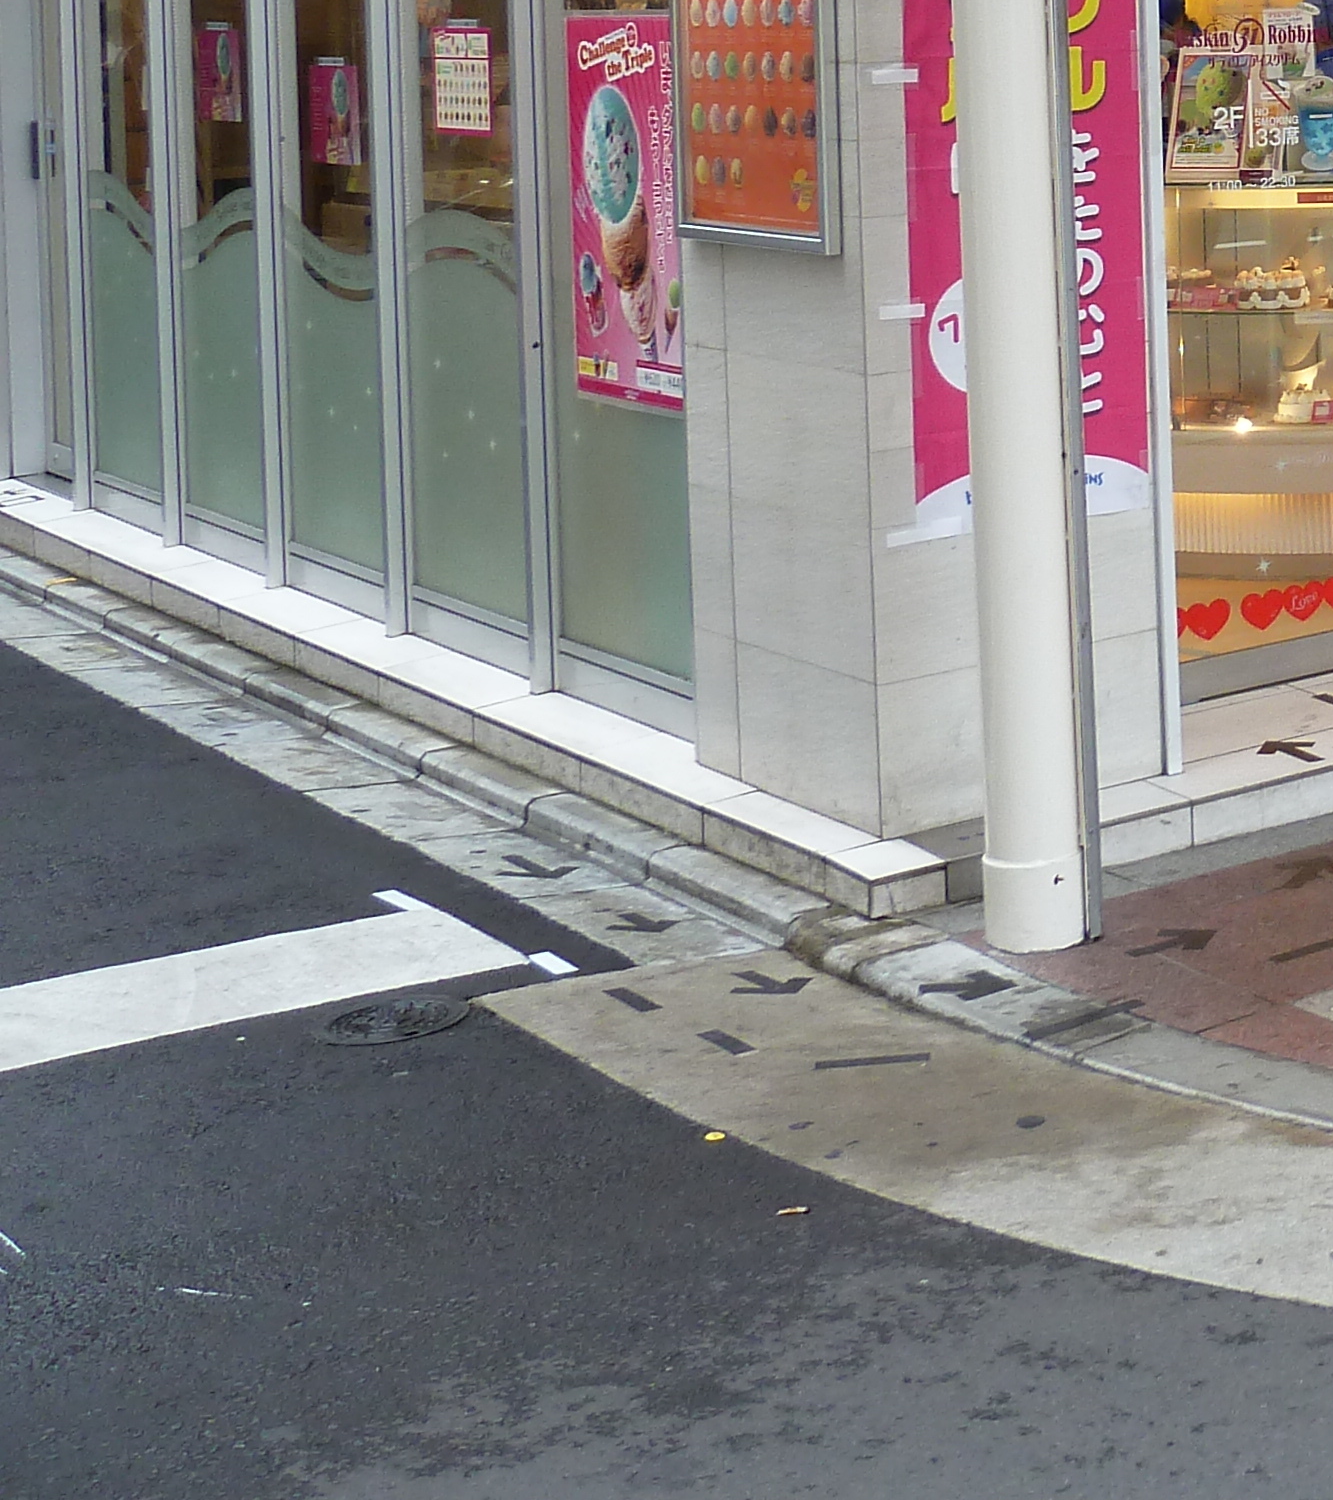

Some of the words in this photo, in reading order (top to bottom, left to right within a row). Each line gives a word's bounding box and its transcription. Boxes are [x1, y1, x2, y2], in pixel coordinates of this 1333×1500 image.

[579, 36, 627, 67] Challenge
[606, 60, 622, 78] the
[621, 47, 653, 72] Triple
[1213, 105, 1245, 131] 2F
[1254, 107, 1269, 117] NO
[1254, 115, 1300, 126] SMOKING
[1255, 126, 1300, 147] 33席
[1207, 178, 1242, 193] 11:00
[1289, 590, 1319, 612] Love
